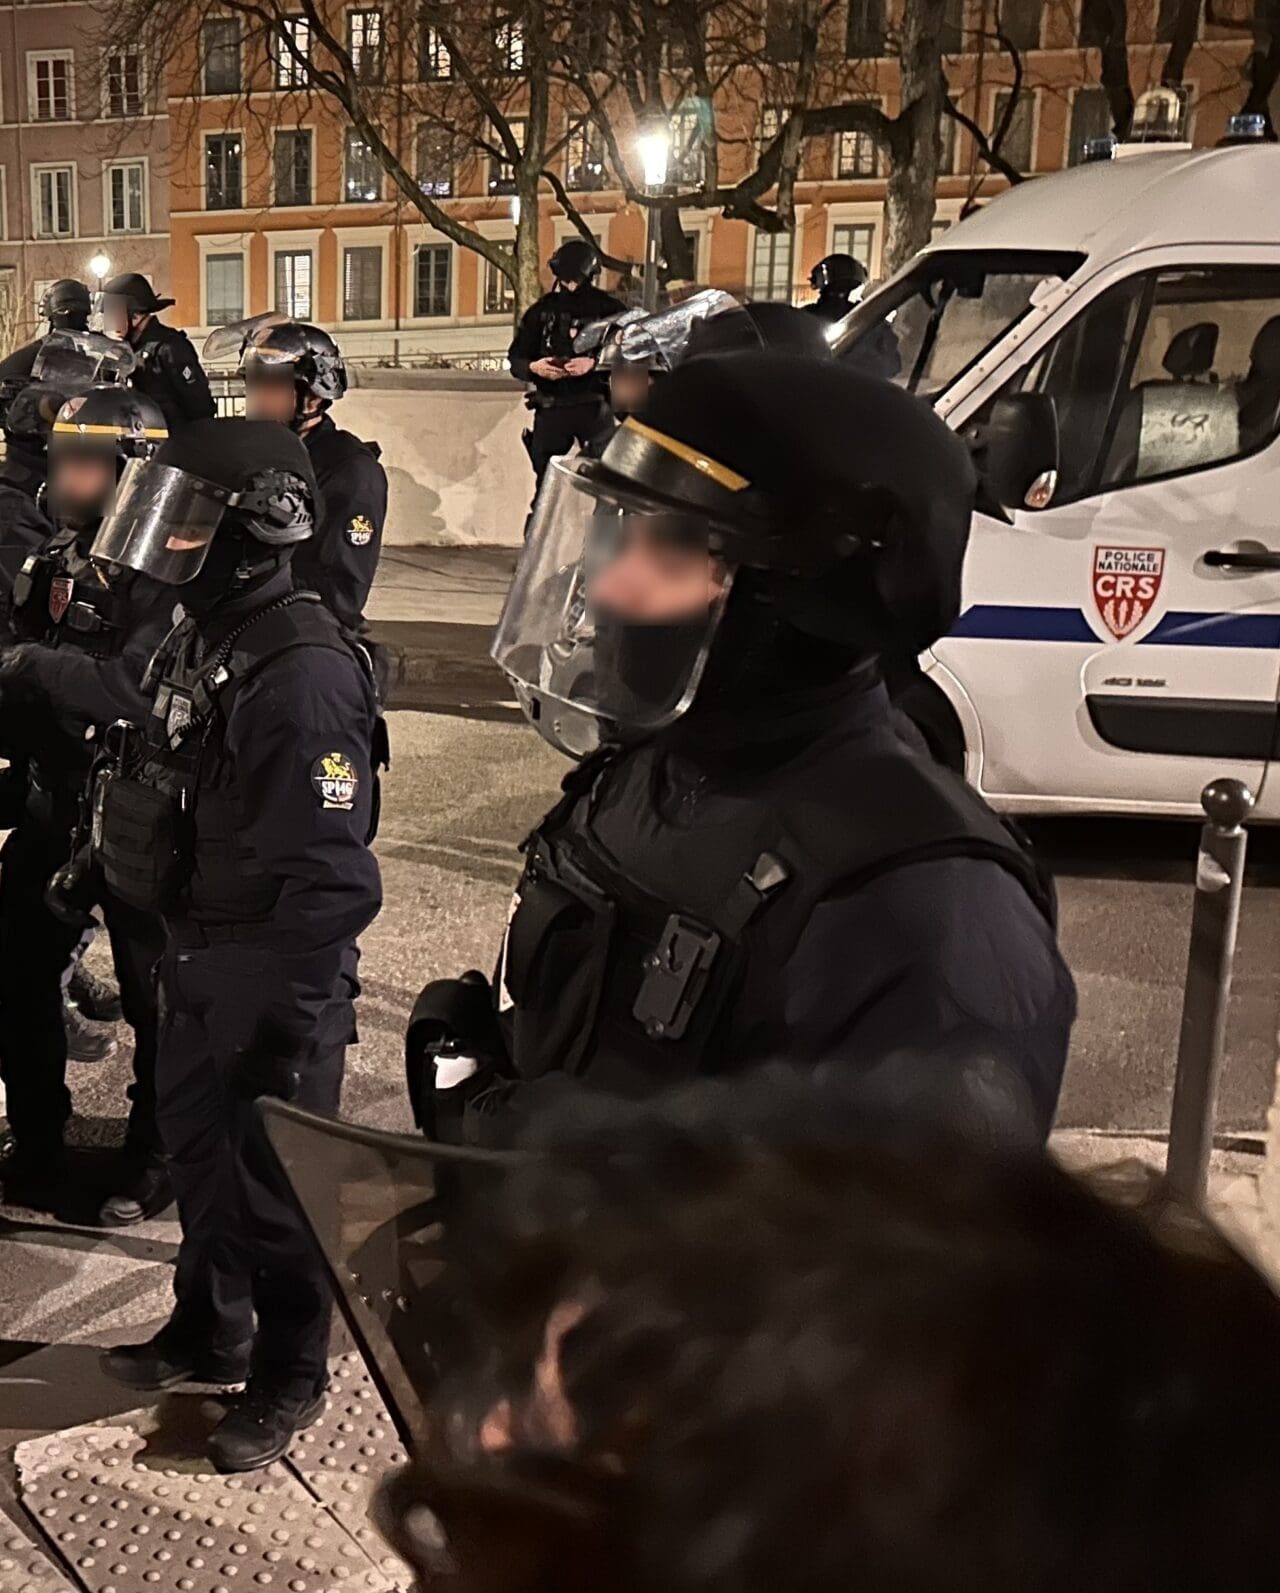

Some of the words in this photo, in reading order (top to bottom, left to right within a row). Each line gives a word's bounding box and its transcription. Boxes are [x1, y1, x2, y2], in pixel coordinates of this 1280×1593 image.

[1104, 551, 1156, 562] POLICE
[1098, 561, 1159, 573] NATIONALE
[1096, 575, 1155, 599] CRS
